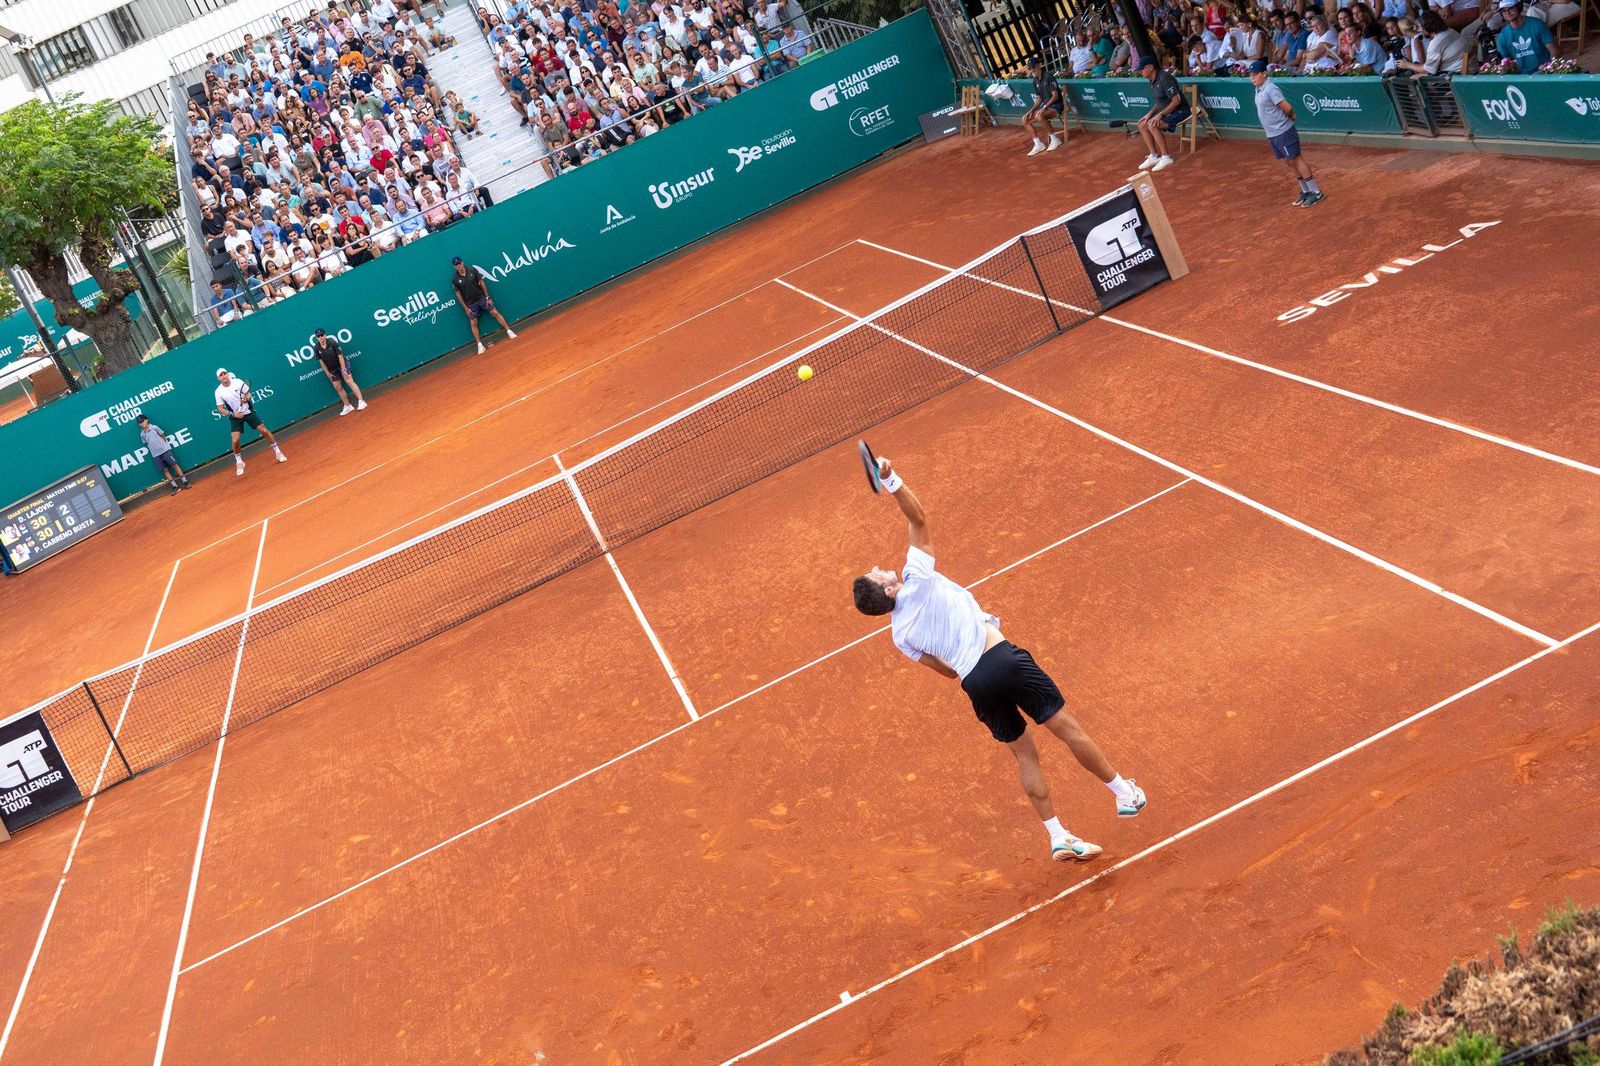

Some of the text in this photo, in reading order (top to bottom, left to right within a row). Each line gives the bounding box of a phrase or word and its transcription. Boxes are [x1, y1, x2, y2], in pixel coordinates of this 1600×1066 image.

[1516, 50, 1534, 58] adidas
[838, 54, 900, 90] CHALLENGER
[841, 81, 870, 100] TOUR
[860, 105, 890, 128] RFET
[932, 106, 954, 118] SPEED
[761, 128, 792, 146] Diputación
[764, 135, 796, 155] Sevilla
[676, 192, 693, 203] GRUPO
[1121, 218, 1137, 232] ATP
[472, 230, 577, 282] Andalucía
[1097, 248, 1155, 283] CHALLENGER
[1100, 273, 1127, 292] TOUR
[1276, 220, 1503, 327] SEVILLA
[373, 290, 440, 327] Sevilla
[108, 380, 175, 417] CHALLENGER
[101, 427, 193, 478] MAPRE
[7, 505, 30, 520] QUARTER
[46, 488, 65, 500] MATCH
[26, 501, 54, 518] LAJOVIC
[30, 504, 69, 529] 30 2
[36, 527, 53, 541] 30
[66, 516, 75, 526] 0
[43, 530, 73, 549] CARRENO
[74, 518, 95, 533] BUSTA
[23, 740, 42, 754] ATP
[2, 796, 32, 815] TOUR
